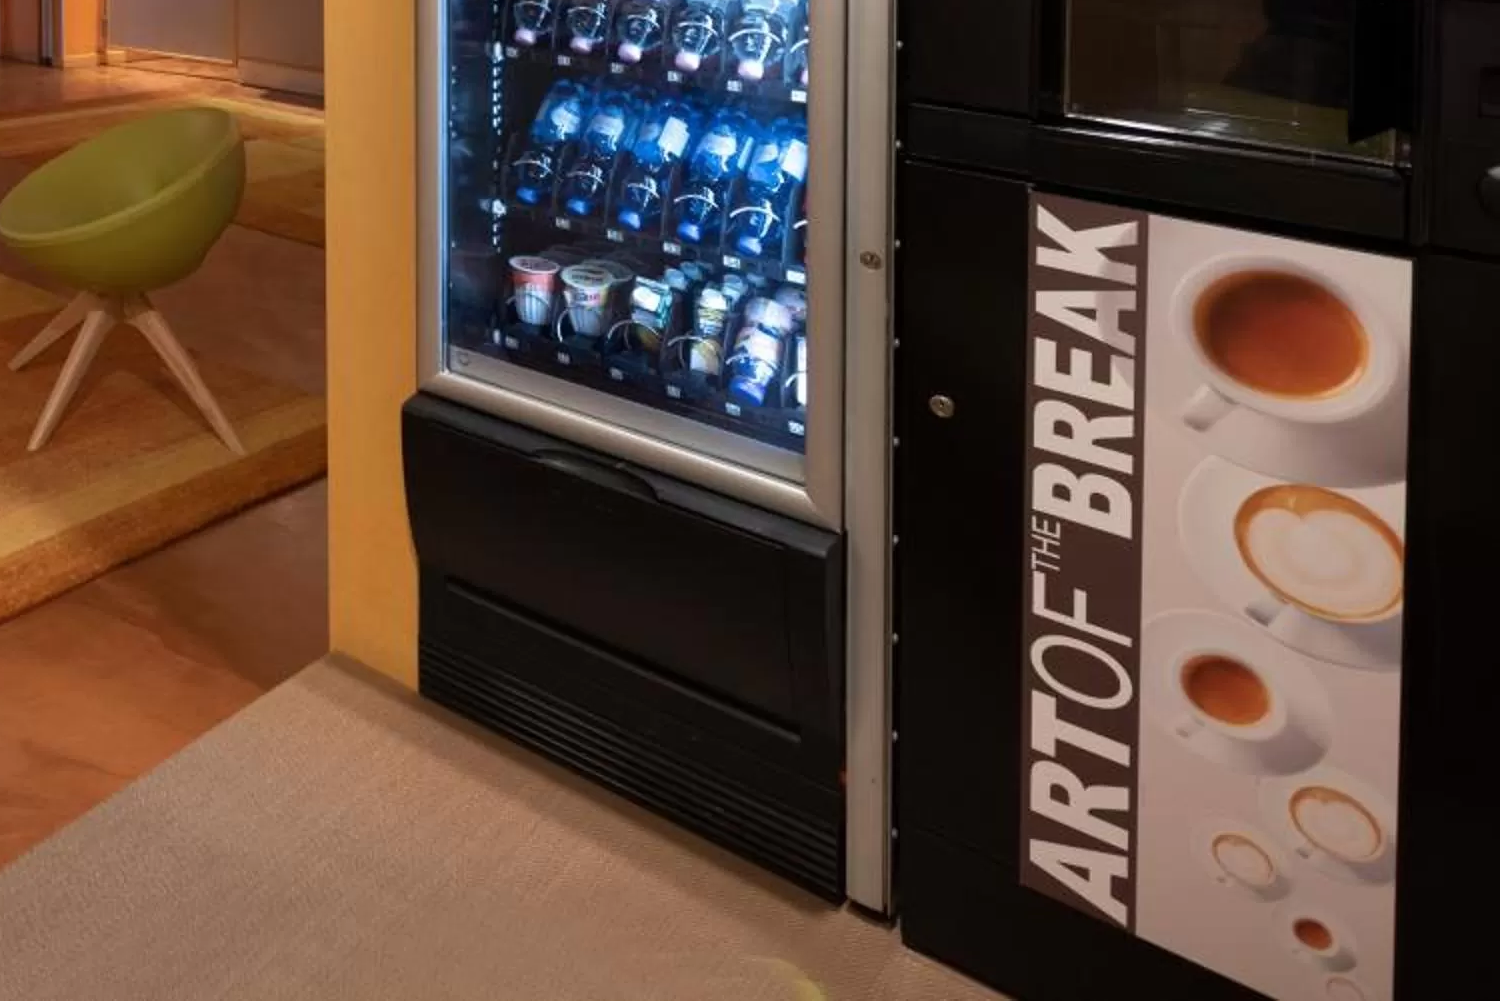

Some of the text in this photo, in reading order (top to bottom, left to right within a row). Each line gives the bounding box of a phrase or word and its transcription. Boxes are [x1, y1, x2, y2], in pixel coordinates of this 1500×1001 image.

[1029, 204, 1140, 927] ART OF THE BREAK
